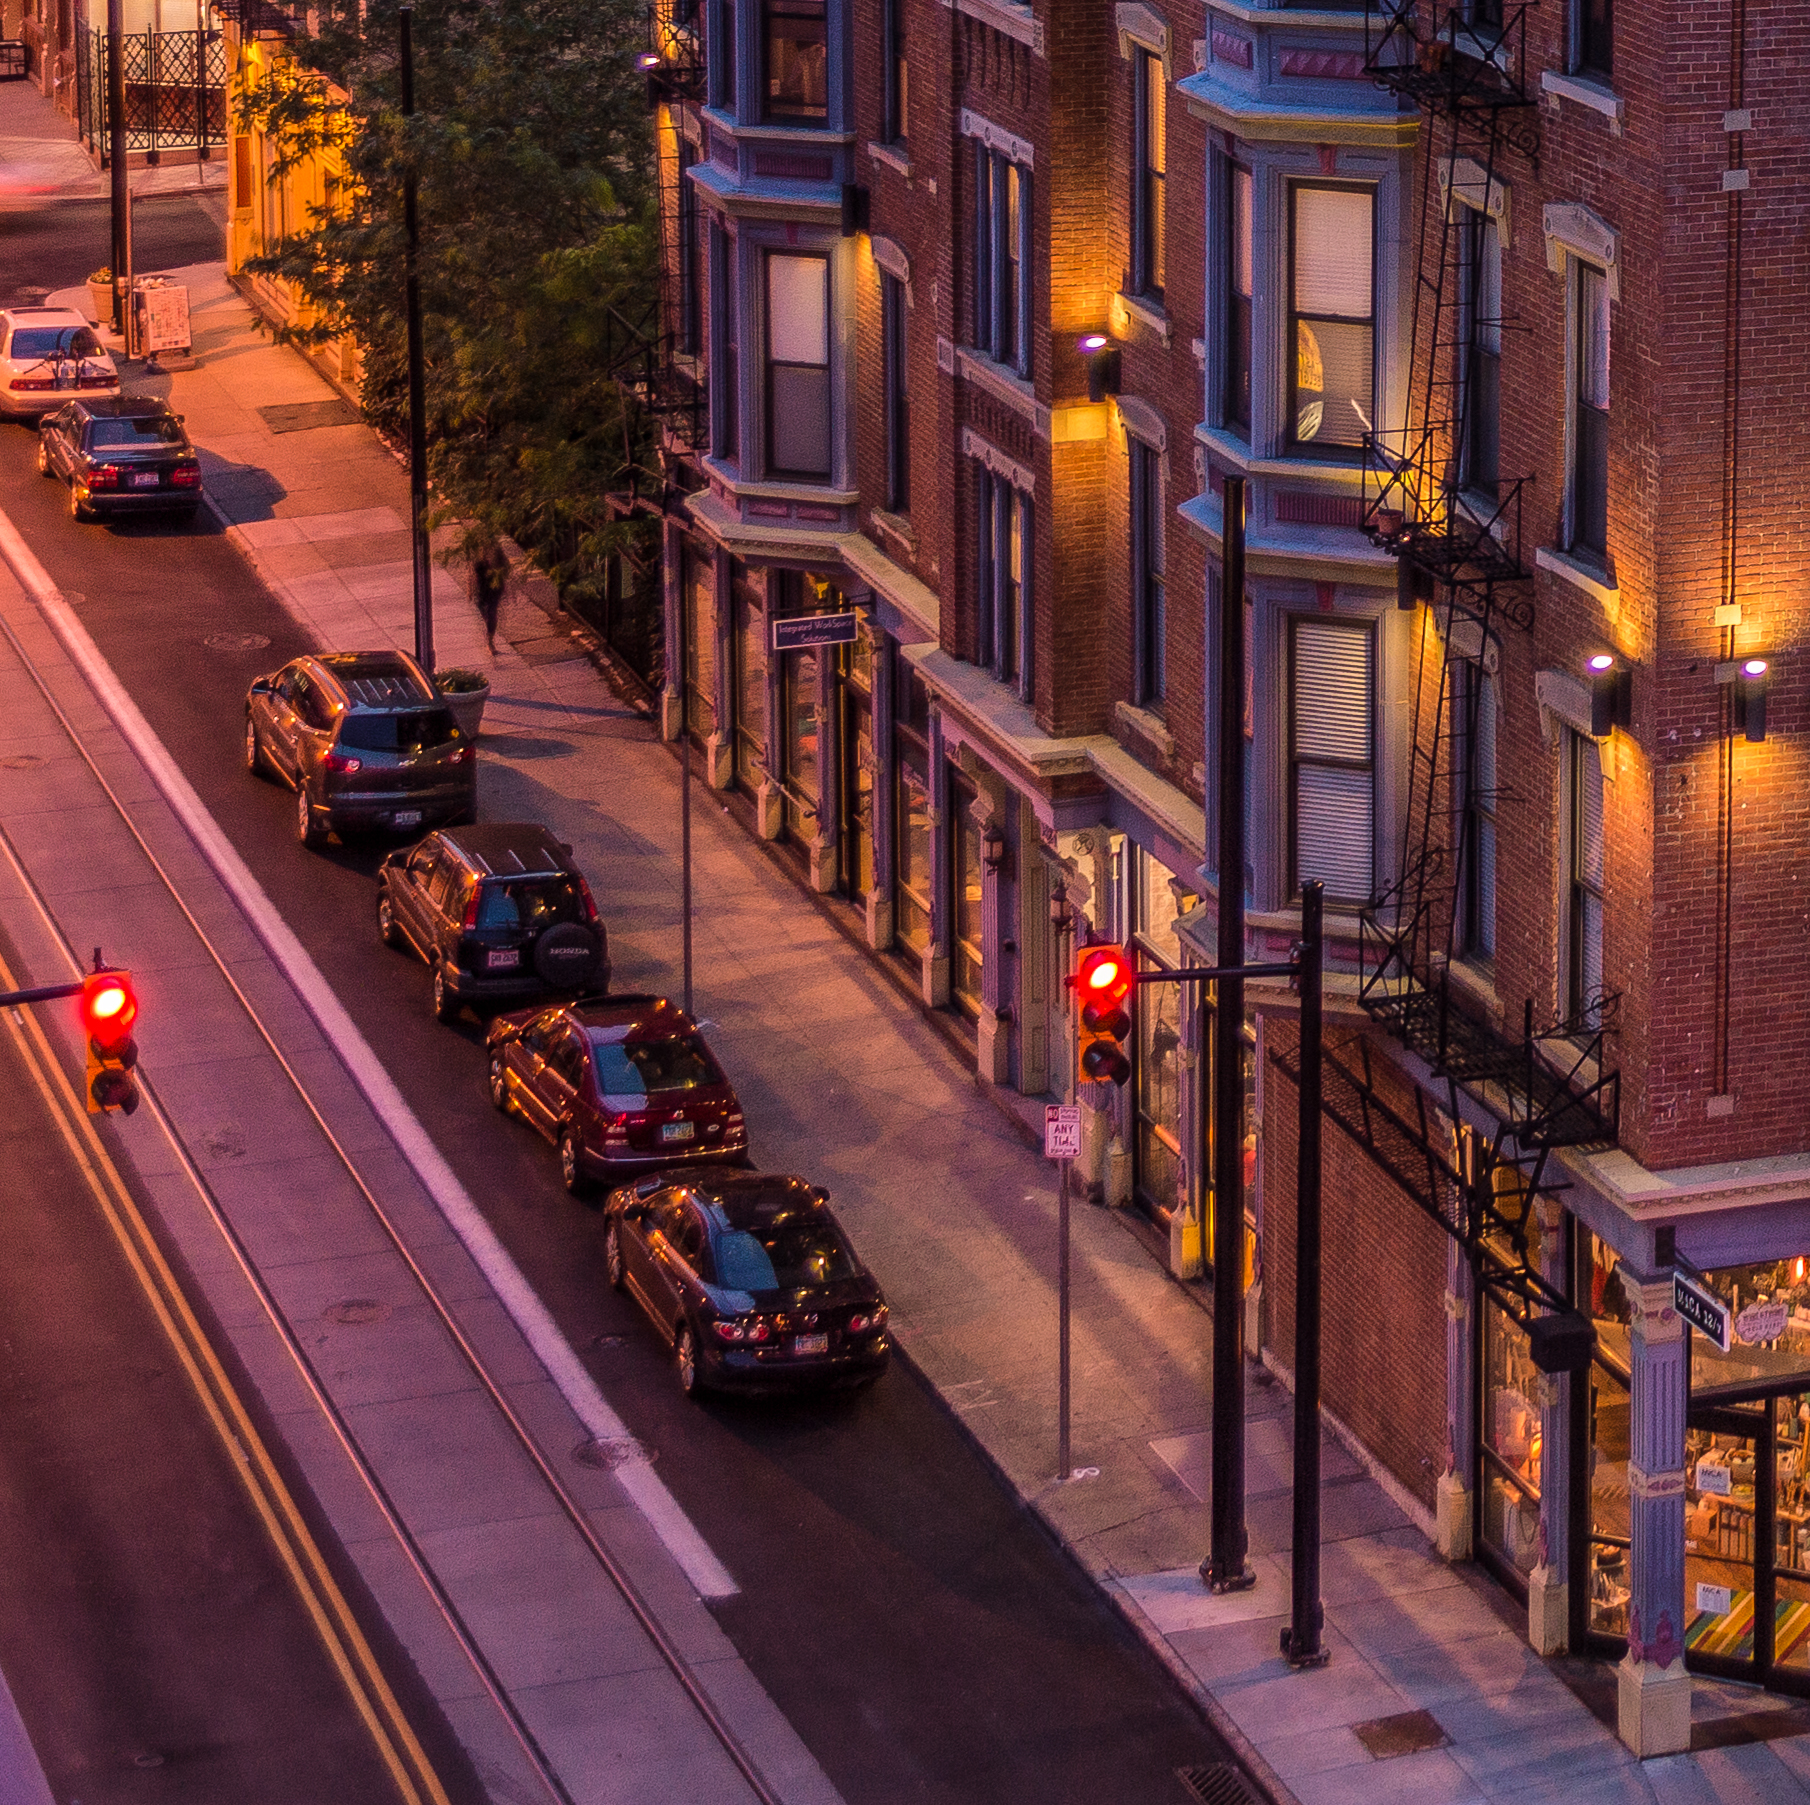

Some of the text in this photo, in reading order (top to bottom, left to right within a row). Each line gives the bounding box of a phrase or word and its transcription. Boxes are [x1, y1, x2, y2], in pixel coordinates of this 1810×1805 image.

[675, 22, 715, 72] C
[550, 947, 590, 955] HONDA
[1054, 1124, 1074, 1134] ANY
